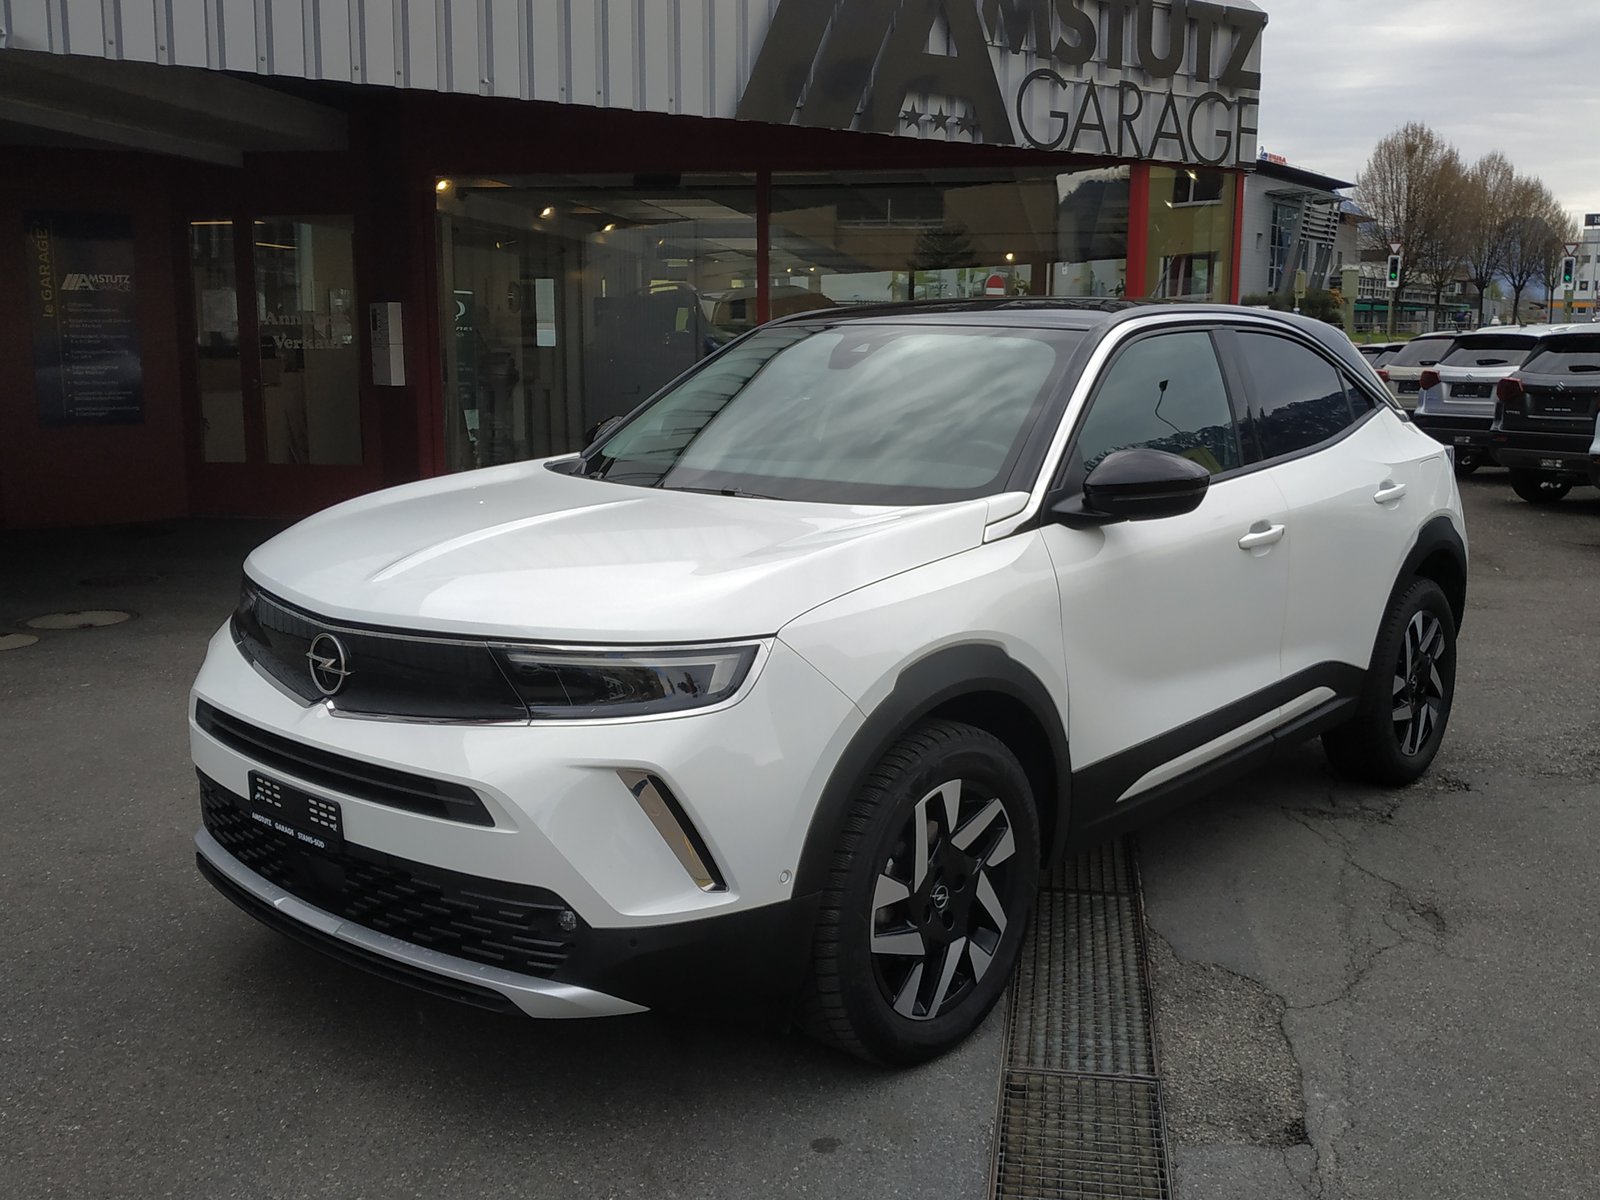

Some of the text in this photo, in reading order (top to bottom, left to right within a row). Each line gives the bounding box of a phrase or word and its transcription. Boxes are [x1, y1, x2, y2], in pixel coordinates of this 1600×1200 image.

[1016, 68, 1259, 168] GARAGE
[36, 228, 54, 318] le GARAGE
[75, 273, 131, 291] AMSTUTZ
[275, 823, 294, 836] GARAGE
